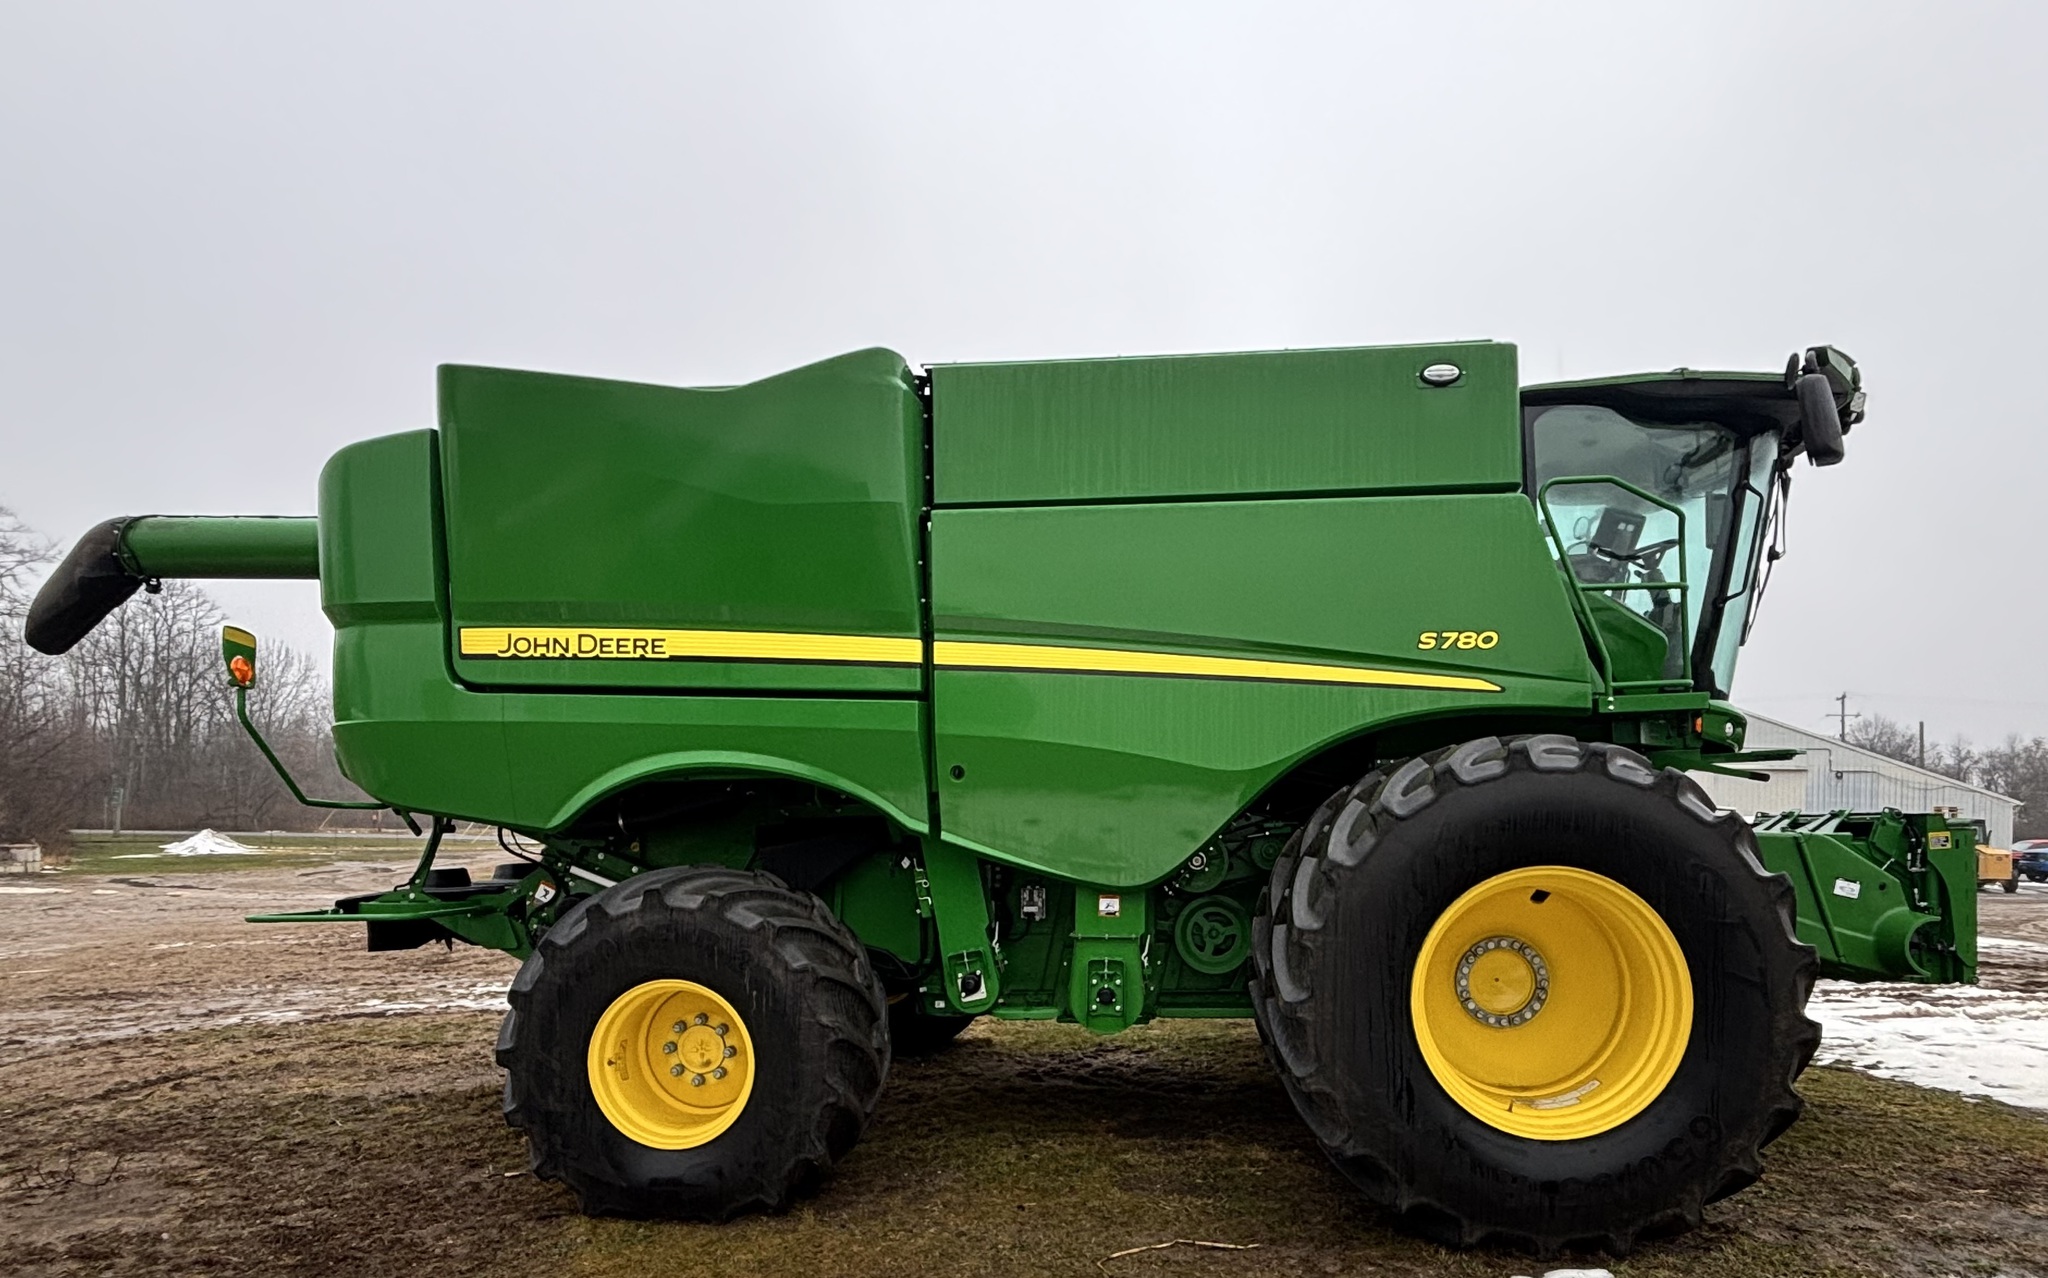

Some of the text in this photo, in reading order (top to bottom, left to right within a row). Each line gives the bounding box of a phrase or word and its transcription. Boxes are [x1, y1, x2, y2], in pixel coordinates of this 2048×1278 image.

[497, 633, 667, 655] JOHN DEERE
[1417, 630, 1500, 650] S780
